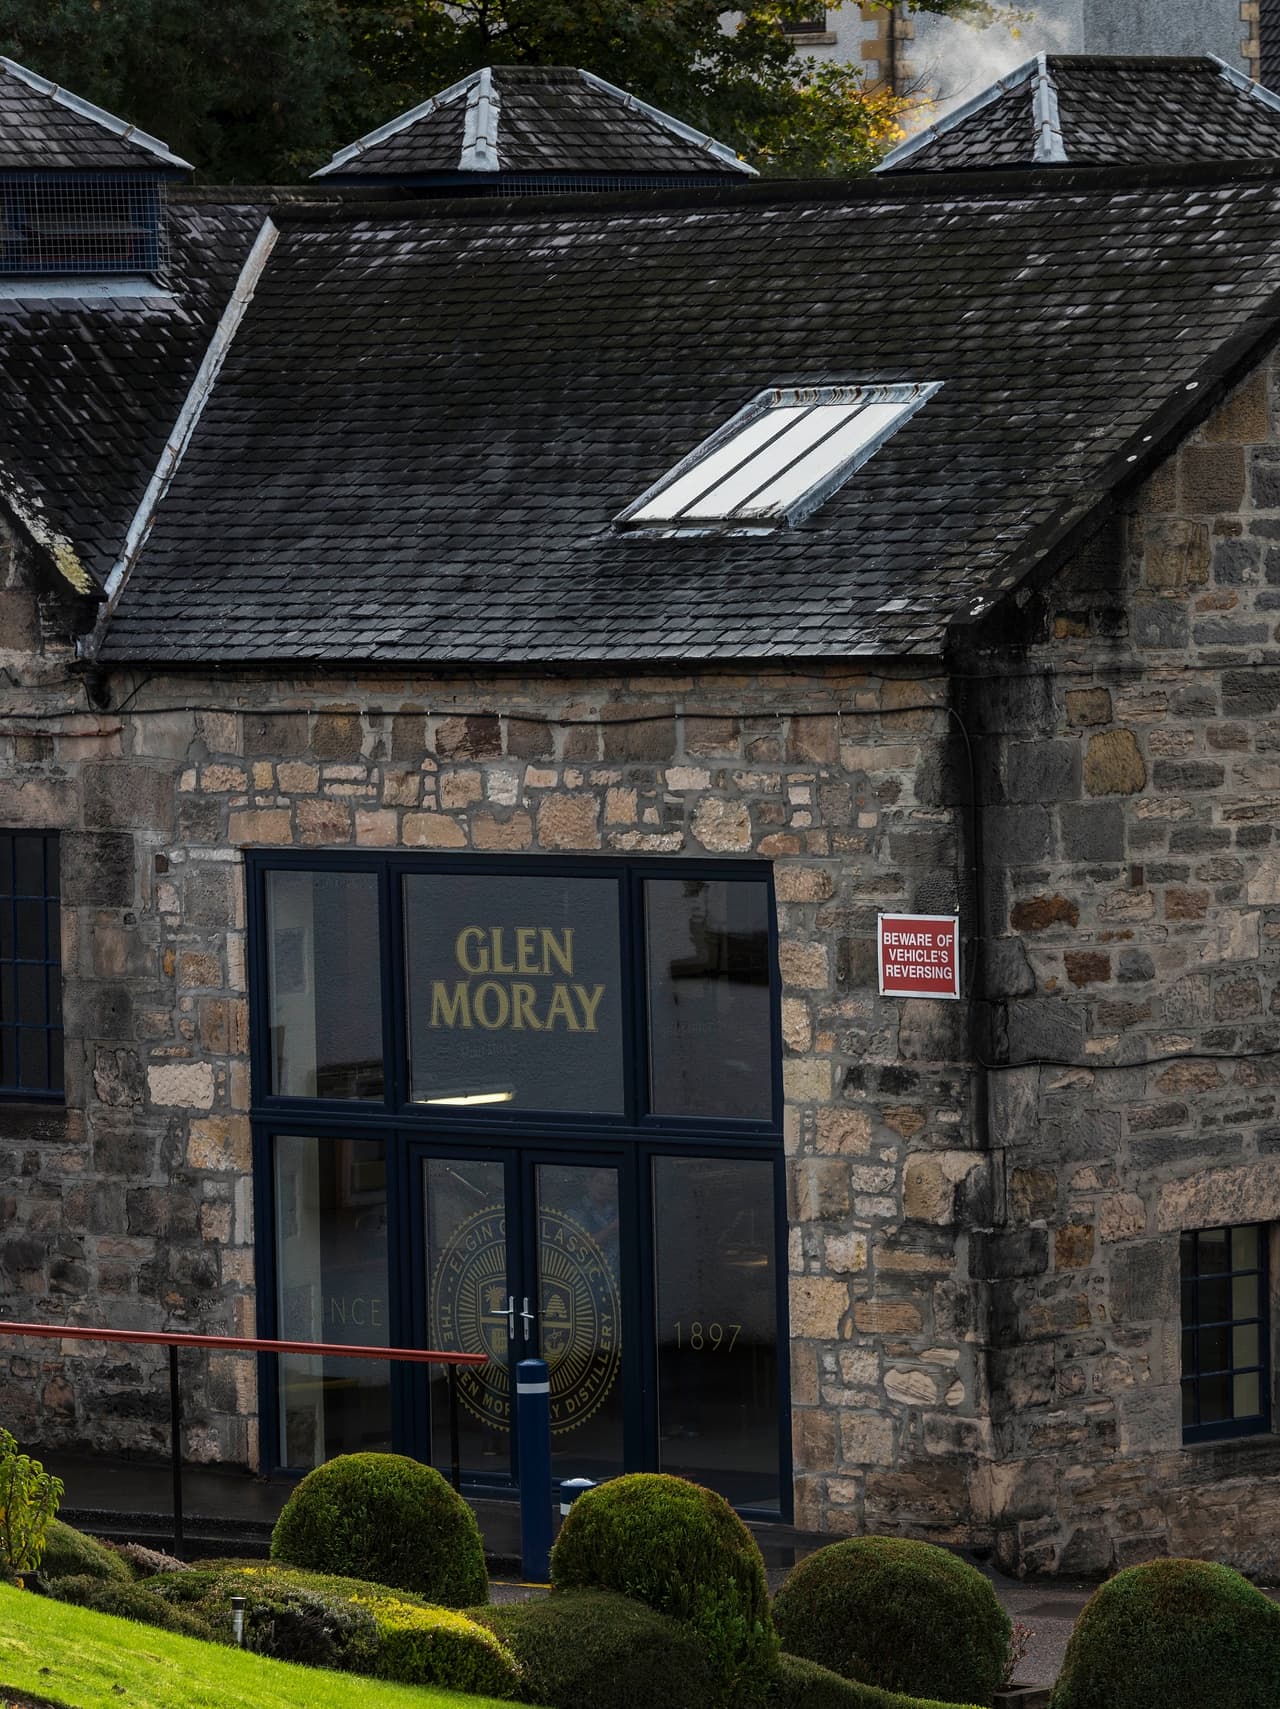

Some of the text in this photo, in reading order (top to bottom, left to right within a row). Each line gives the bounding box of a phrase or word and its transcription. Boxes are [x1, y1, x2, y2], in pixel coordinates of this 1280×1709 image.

[455, 925, 575, 976] GLEN
[884, 932, 953, 947] BEWARE OF
[889, 948, 949, 963] VEHICLE'S
[886, 964, 952, 979] REVERSING
[426, 979, 606, 1032] MORAY
[451, 1223, 493, 1274] ELGIN
[320, 1295, 383, 1326] INCE
[673, 1321, 742, 1352] 1897
[441, 1303, 454, 1342] THE
[566, 1313, 612, 1413] DISTILLERY
